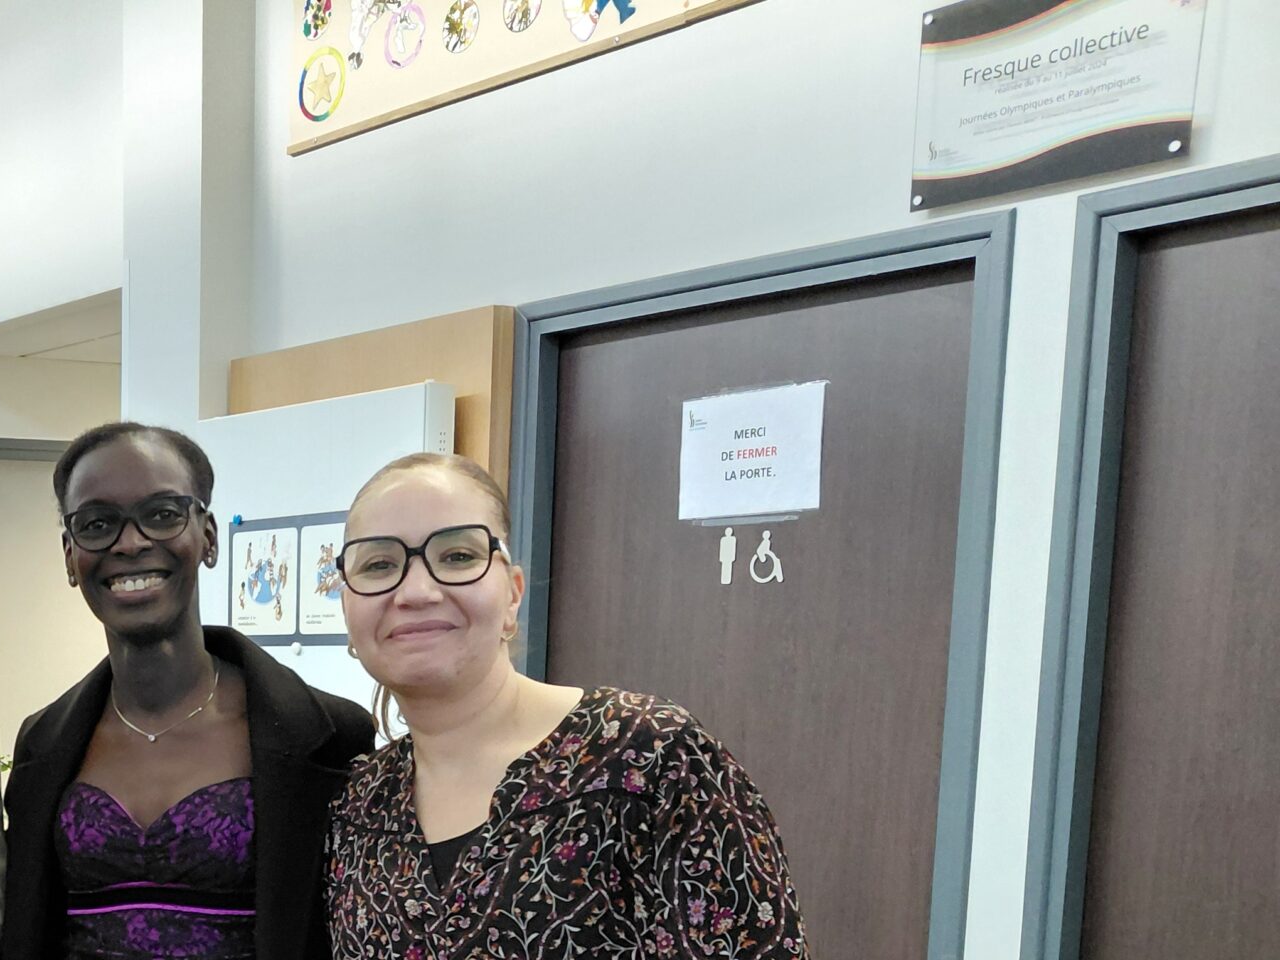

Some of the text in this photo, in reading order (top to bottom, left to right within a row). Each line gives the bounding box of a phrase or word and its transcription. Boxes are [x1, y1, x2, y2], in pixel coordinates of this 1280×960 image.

[962, 23, 1150, 87] Fresque collective
[959, 110, 998, 128] Journées
[999, 98, 1054, 117] Olympiques
[1056, 92, 1066, 103] et
[1068, 74, 1142, 100] Paralympiques
[734, 426, 766, 440] MERCI
[721, 445, 778, 462] DE FERMER
[724, 466, 776, 481] LA PORTE.
